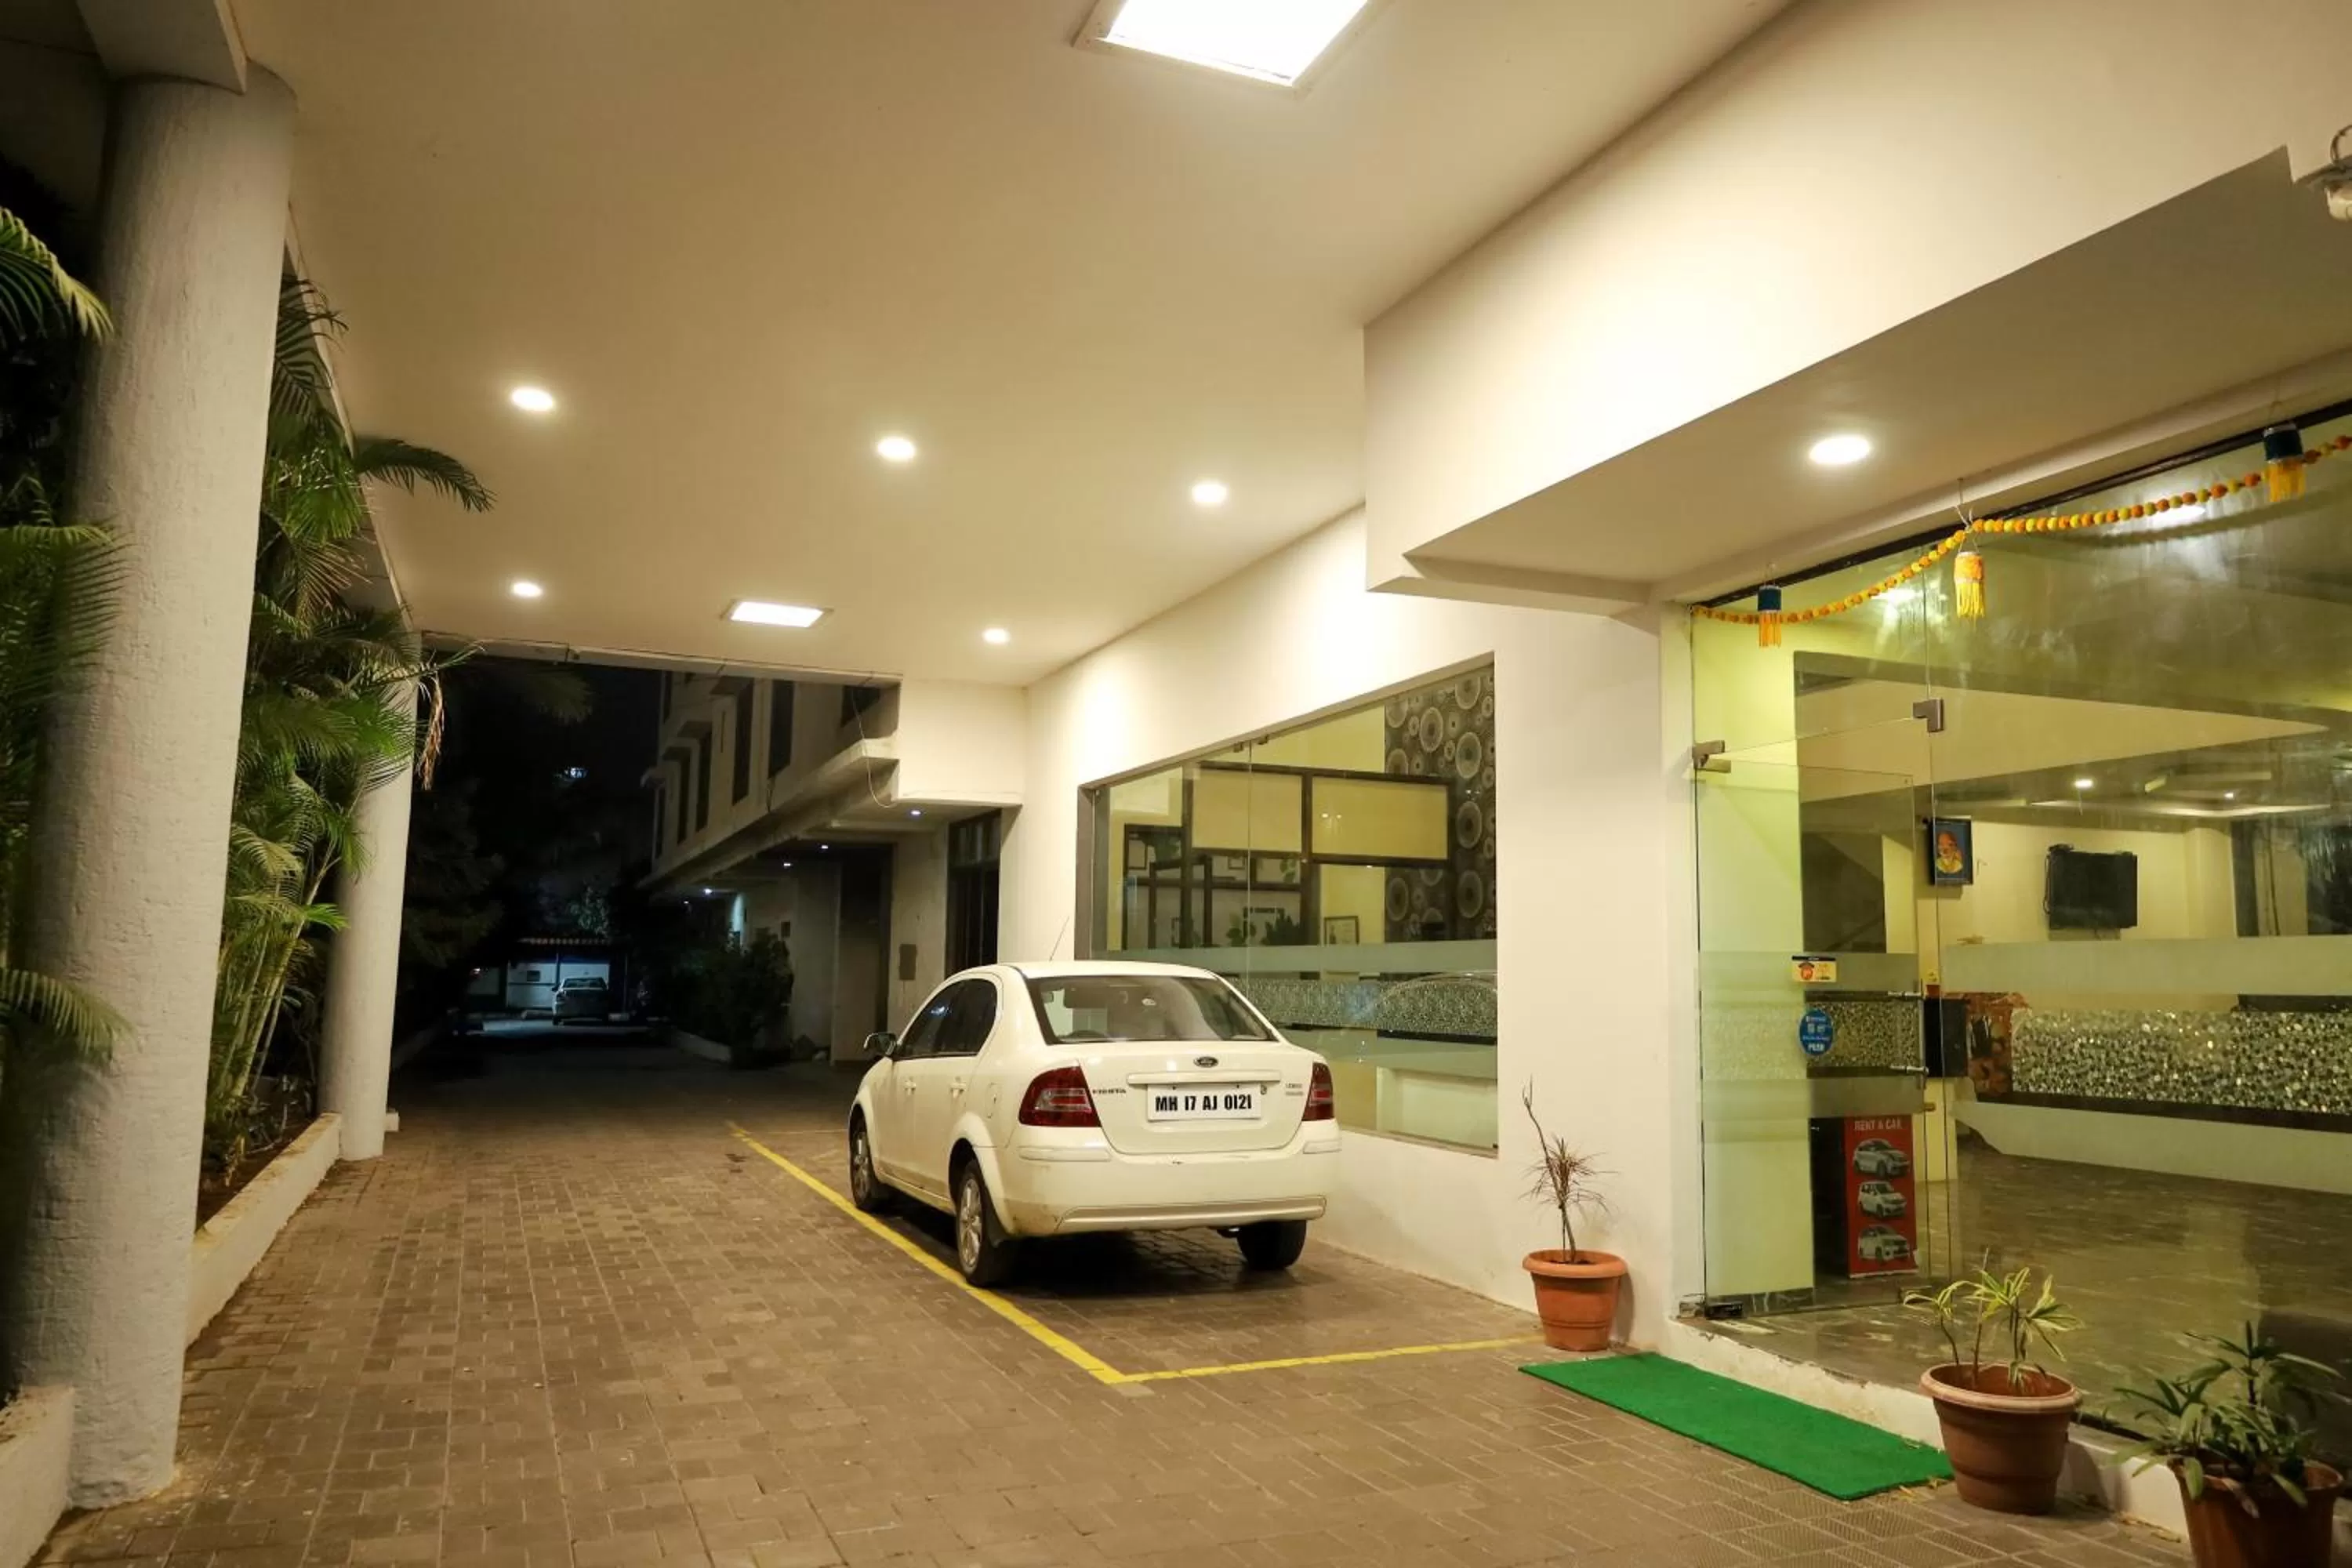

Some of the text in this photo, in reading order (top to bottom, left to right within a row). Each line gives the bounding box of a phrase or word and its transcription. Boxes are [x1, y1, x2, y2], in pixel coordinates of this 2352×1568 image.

[1155, 1094, 1253, 1112] MH 17 AJ 0121
[1854, 1120, 1875, 1131] RENT
